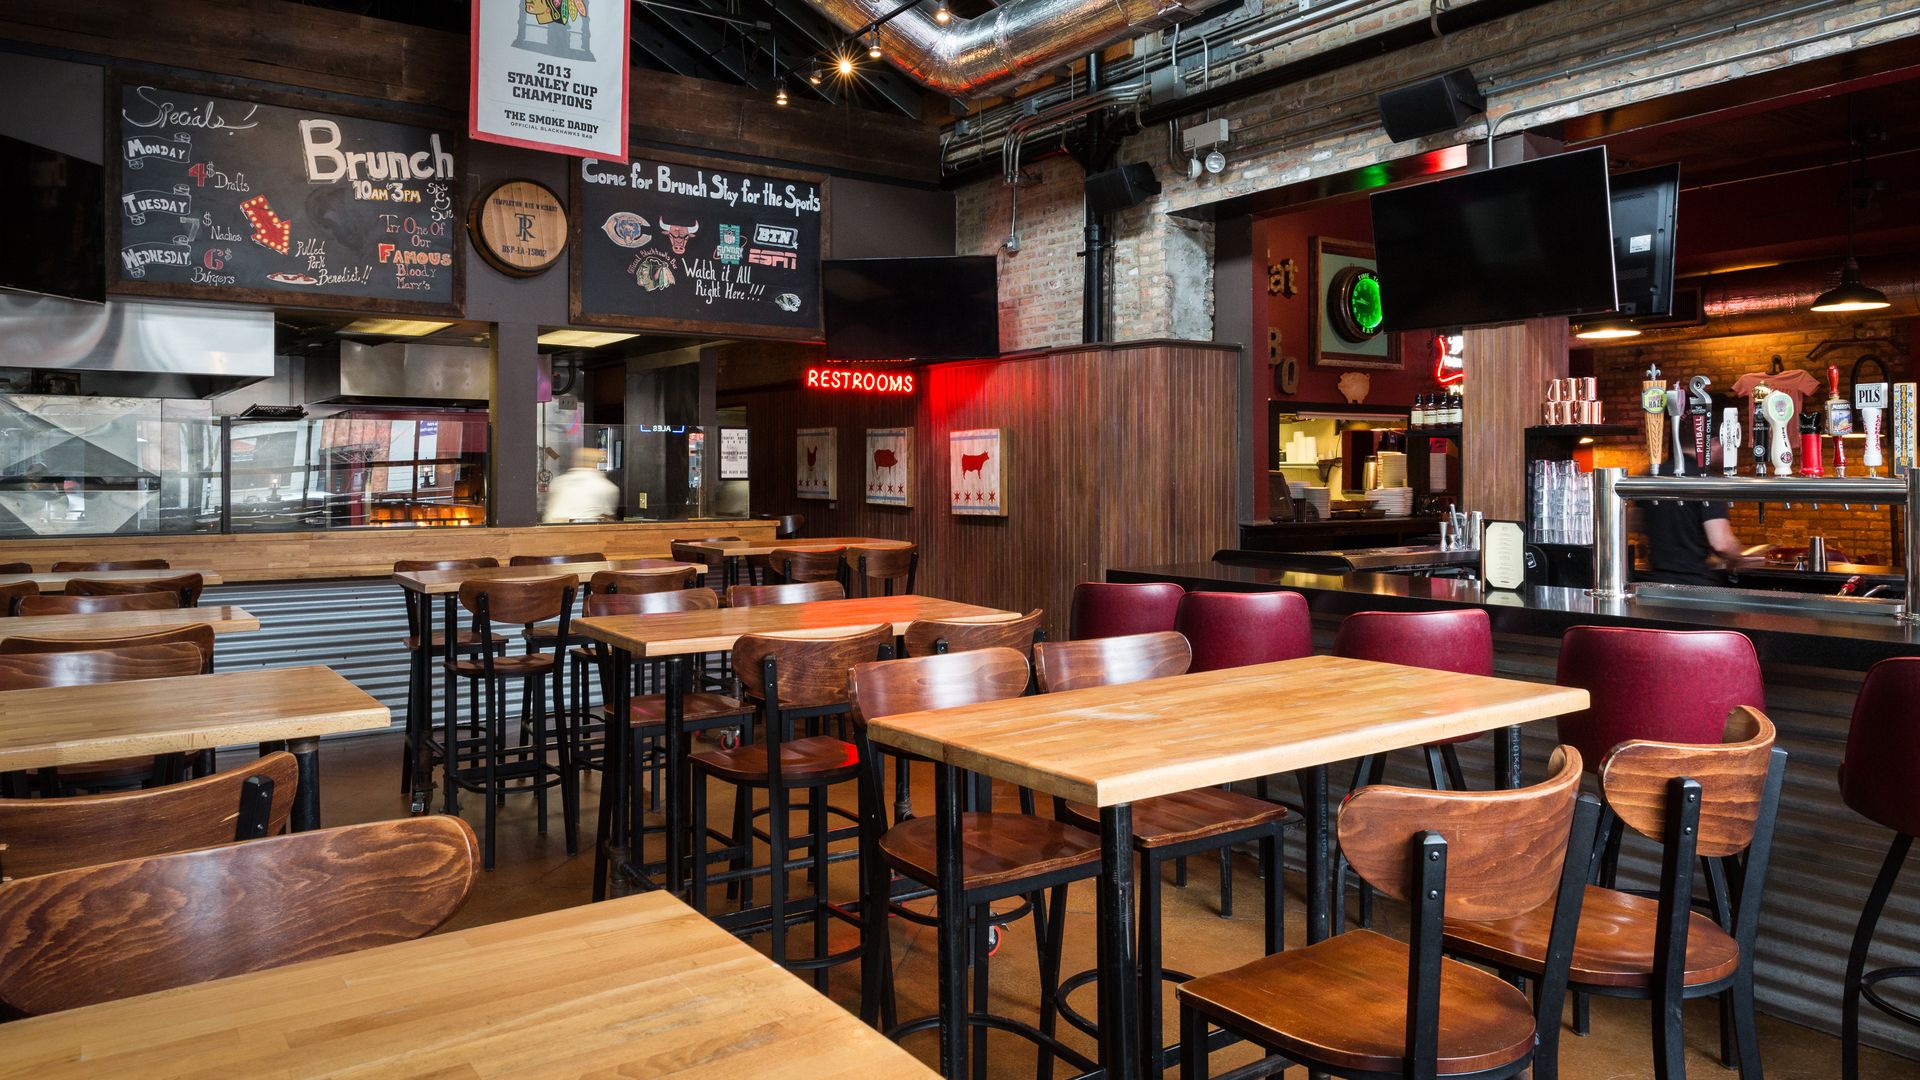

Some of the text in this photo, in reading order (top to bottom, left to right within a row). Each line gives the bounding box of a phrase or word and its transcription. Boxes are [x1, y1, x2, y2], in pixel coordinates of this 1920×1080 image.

[537, 62, 571, 79] 2013
[507, 71, 598, 97] STANLEY CUP
[512, 86, 592, 110] CHAMPIONS
[504, 109, 599, 134] THE SMOKE DADDY
[510, 121, 538, 130] OFFICIAL
[540, 126, 580, 137] BLACKHAWKS
[298, 119, 455, 184] Brunch
[214, 172, 250, 192] Drafts
[582, 158, 821, 217] Come for Brunch Stay for the Sports
[211, 226, 242, 241] Nachos
[403, 217, 428, 235] One
[430, 222, 446, 236] Of
[757, 228, 792, 244] BTN
[295, 238, 326, 257] Pulled
[378, 243, 453, 266] FAMOUS
[716, 245, 743, 257] SUNDAY
[307, 256, 326, 271] Pork
[749, 248, 797, 270] ESPN
[191, 267, 235, 286] Burgers
[682, 258, 752, 284] Watch it All
[695, 280, 720, 304] Right
[807, 369, 914, 393] RESTROOMS
[1859, 388, 1881, 404] PILS
[1696, 416, 1705, 453] PINBALL
